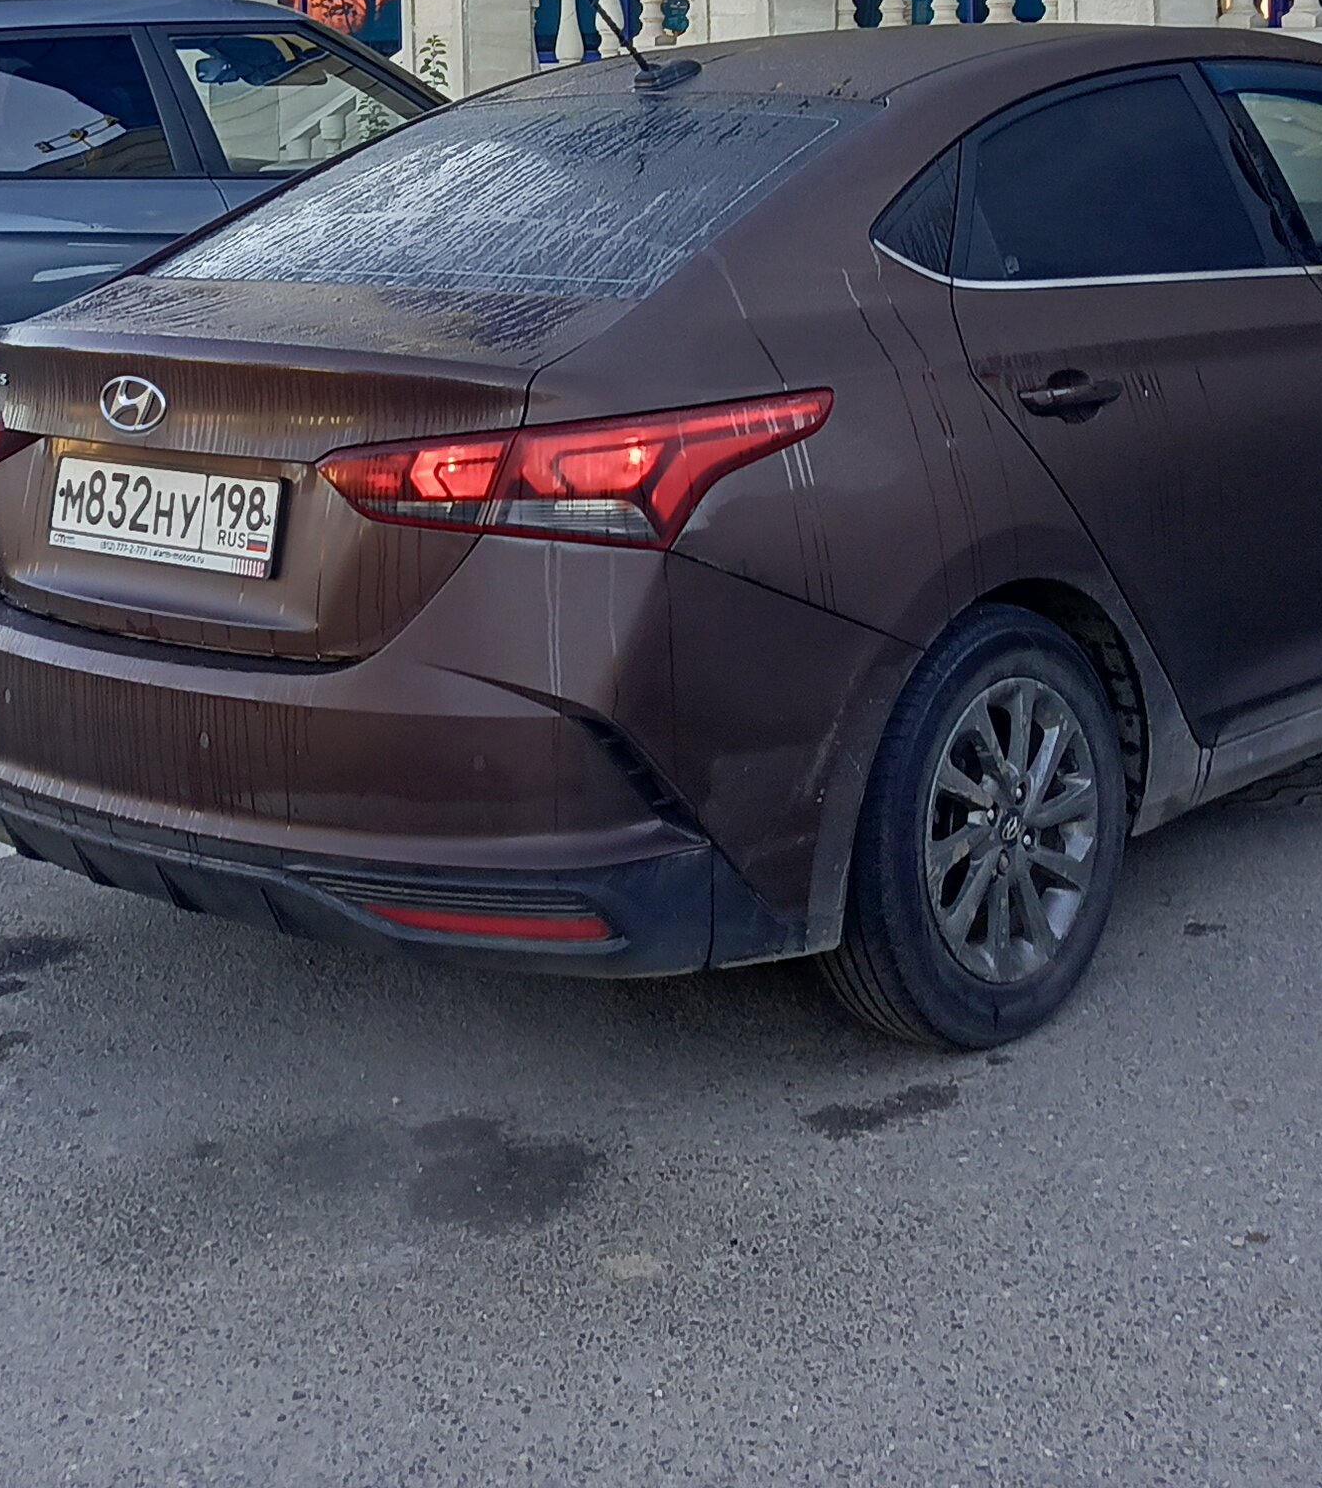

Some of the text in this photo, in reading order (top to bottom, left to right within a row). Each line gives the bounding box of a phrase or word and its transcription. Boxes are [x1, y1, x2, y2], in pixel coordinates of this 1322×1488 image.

[62, 470, 267, 539] М832НУ 198
[217, 529, 246, 548] RUS
